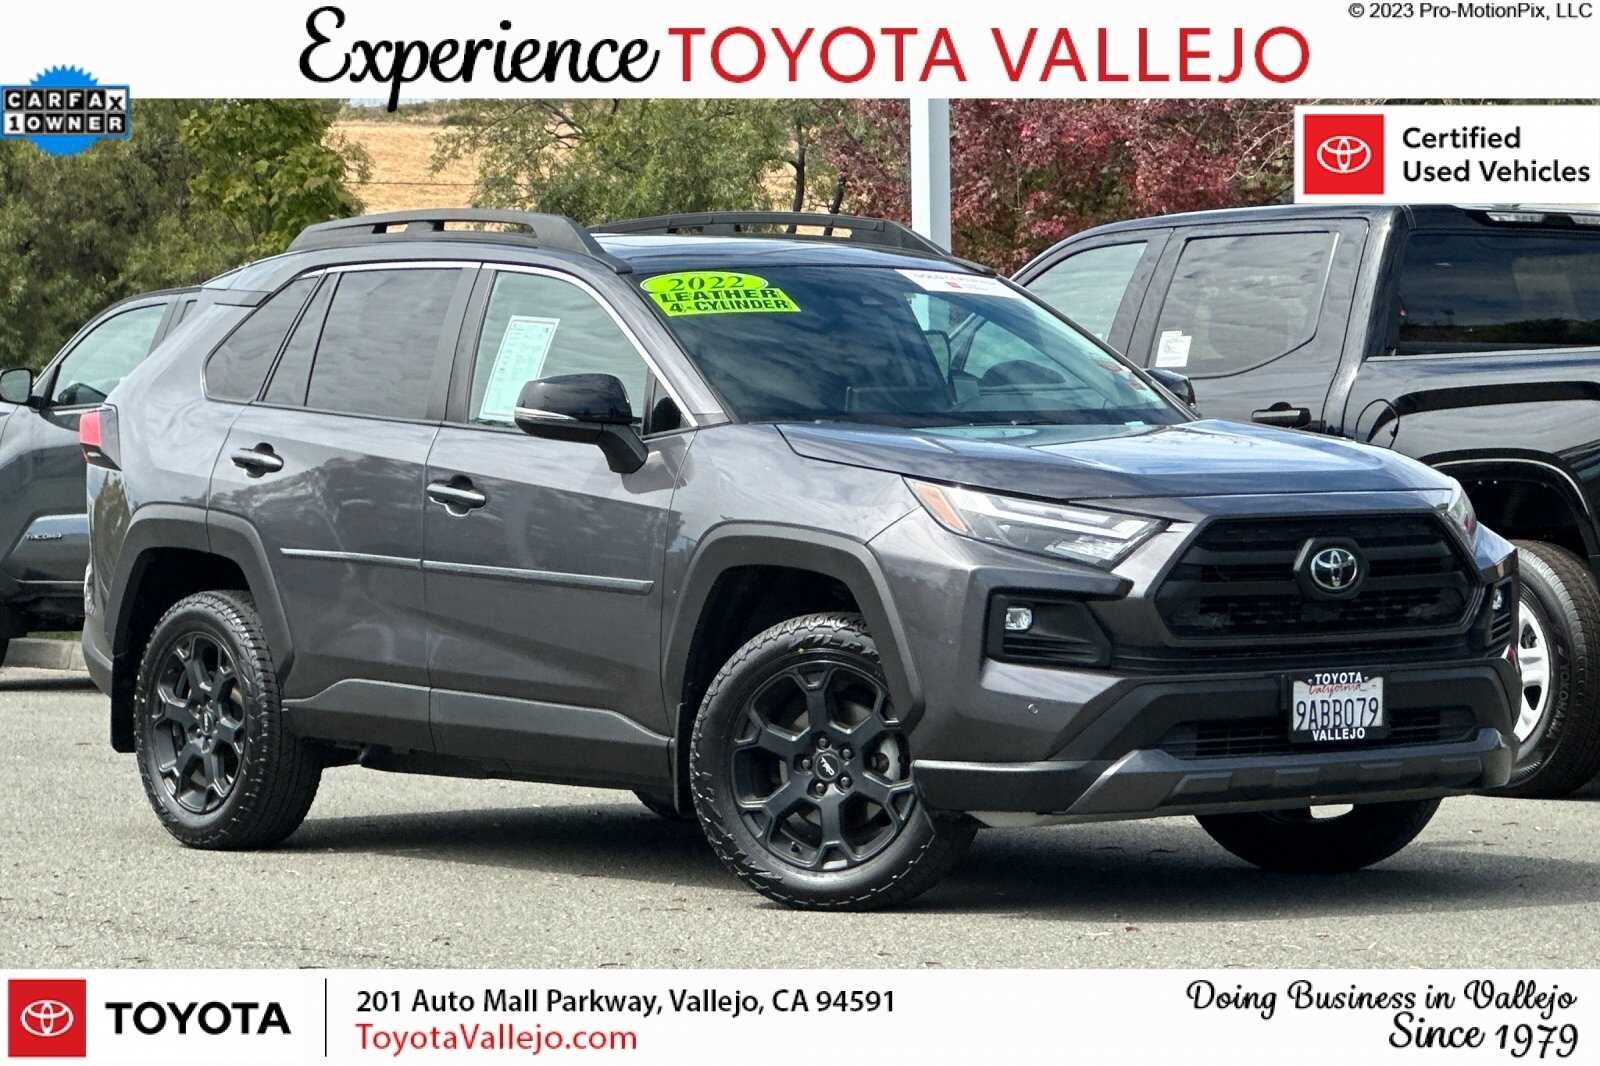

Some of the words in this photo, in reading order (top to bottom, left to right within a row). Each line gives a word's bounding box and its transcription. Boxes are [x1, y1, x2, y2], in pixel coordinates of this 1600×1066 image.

[668, 276, 744, 291] 2022
[660, 290, 778, 302] LEATHER
[1315, 672, 1362, 685] TOYOTA
[1295, 697, 1379, 731] 9ABB079
[1312, 727, 1366, 742] VALLEJO
